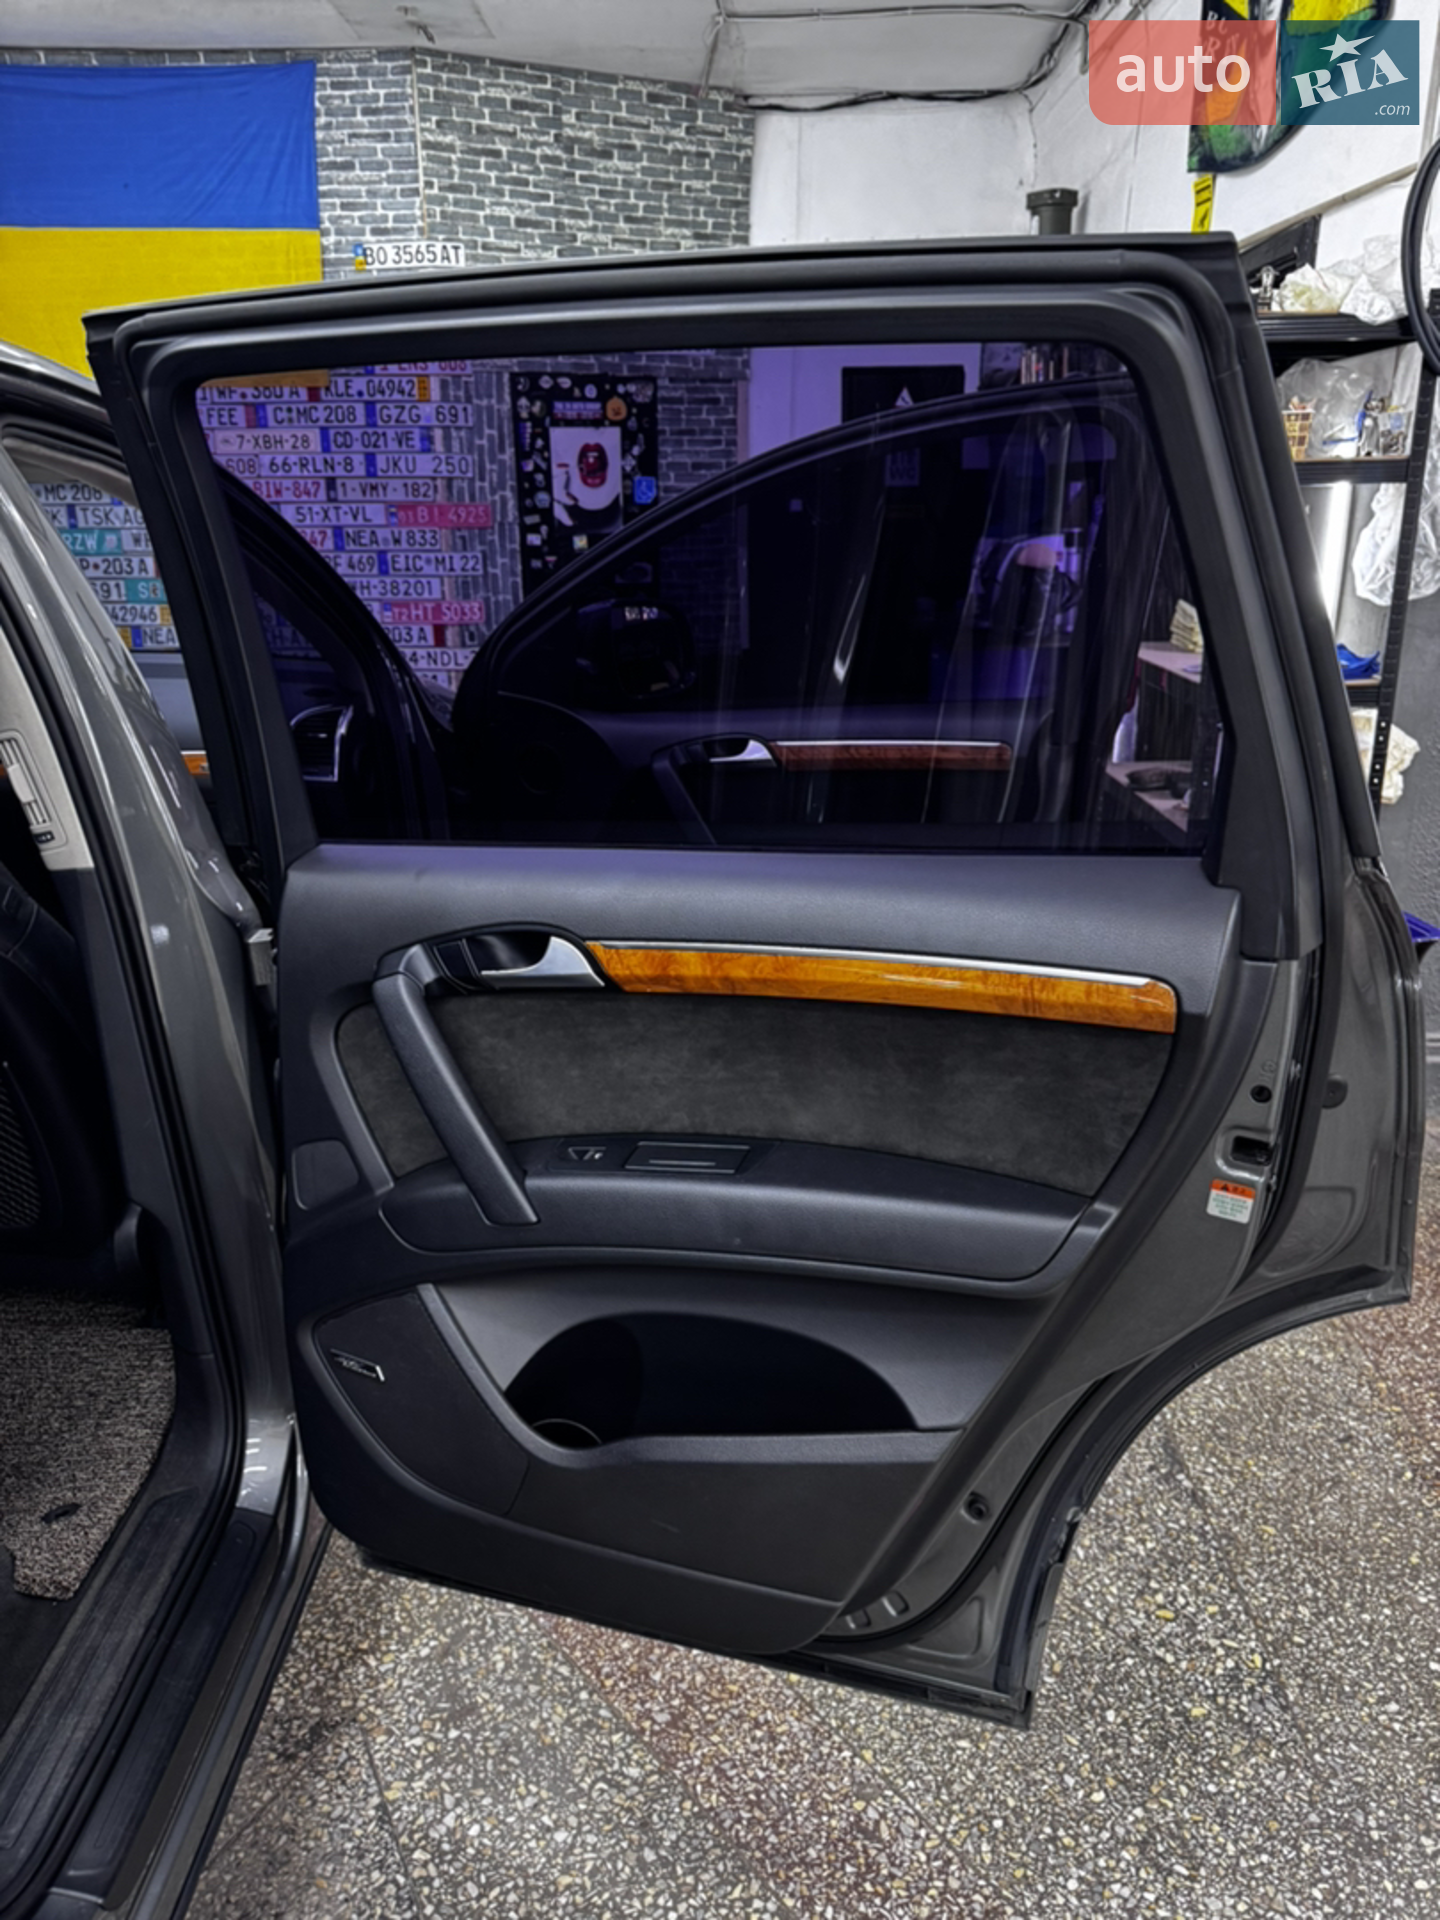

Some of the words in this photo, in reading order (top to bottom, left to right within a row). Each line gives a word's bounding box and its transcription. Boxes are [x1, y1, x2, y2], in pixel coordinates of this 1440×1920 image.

[366, 246, 388, 265] BO
[392, 244, 437, 265] 3565
[441, 244, 461, 264] AT
[366, 379, 416, 397] 04942
[206, 407, 238, 426] FEE
[296, 406, 320, 424] MC
[323, 405, 357, 424] 208
[379, 405, 421, 424] GZG
[435, 404, 470, 424] 691
[379, 455, 416, 474] JKU
[433, 456, 470, 475] 250
[44, 484, 67, 501] MC
[80, 508, 116, 526] TSK
[448, 505, 488, 524] 4925
[345, 530, 380, 547] NEA
[391, 529, 404, 547] W
[406, 528, 439, 547] 833
[102, 558, 134, 575] 203
[138, 558, 149, 575] A
[347, 554, 376, 573] 469
[391, 555, 424, 573] EIC
[434, 555, 456, 573] MI
[457, 554, 480, 572] 22
[410, 602, 436, 621] HT
[441, 602, 481, 621] 5033
[143, 628, 176, 645] NEA
[418, 626, 429, 643] A
